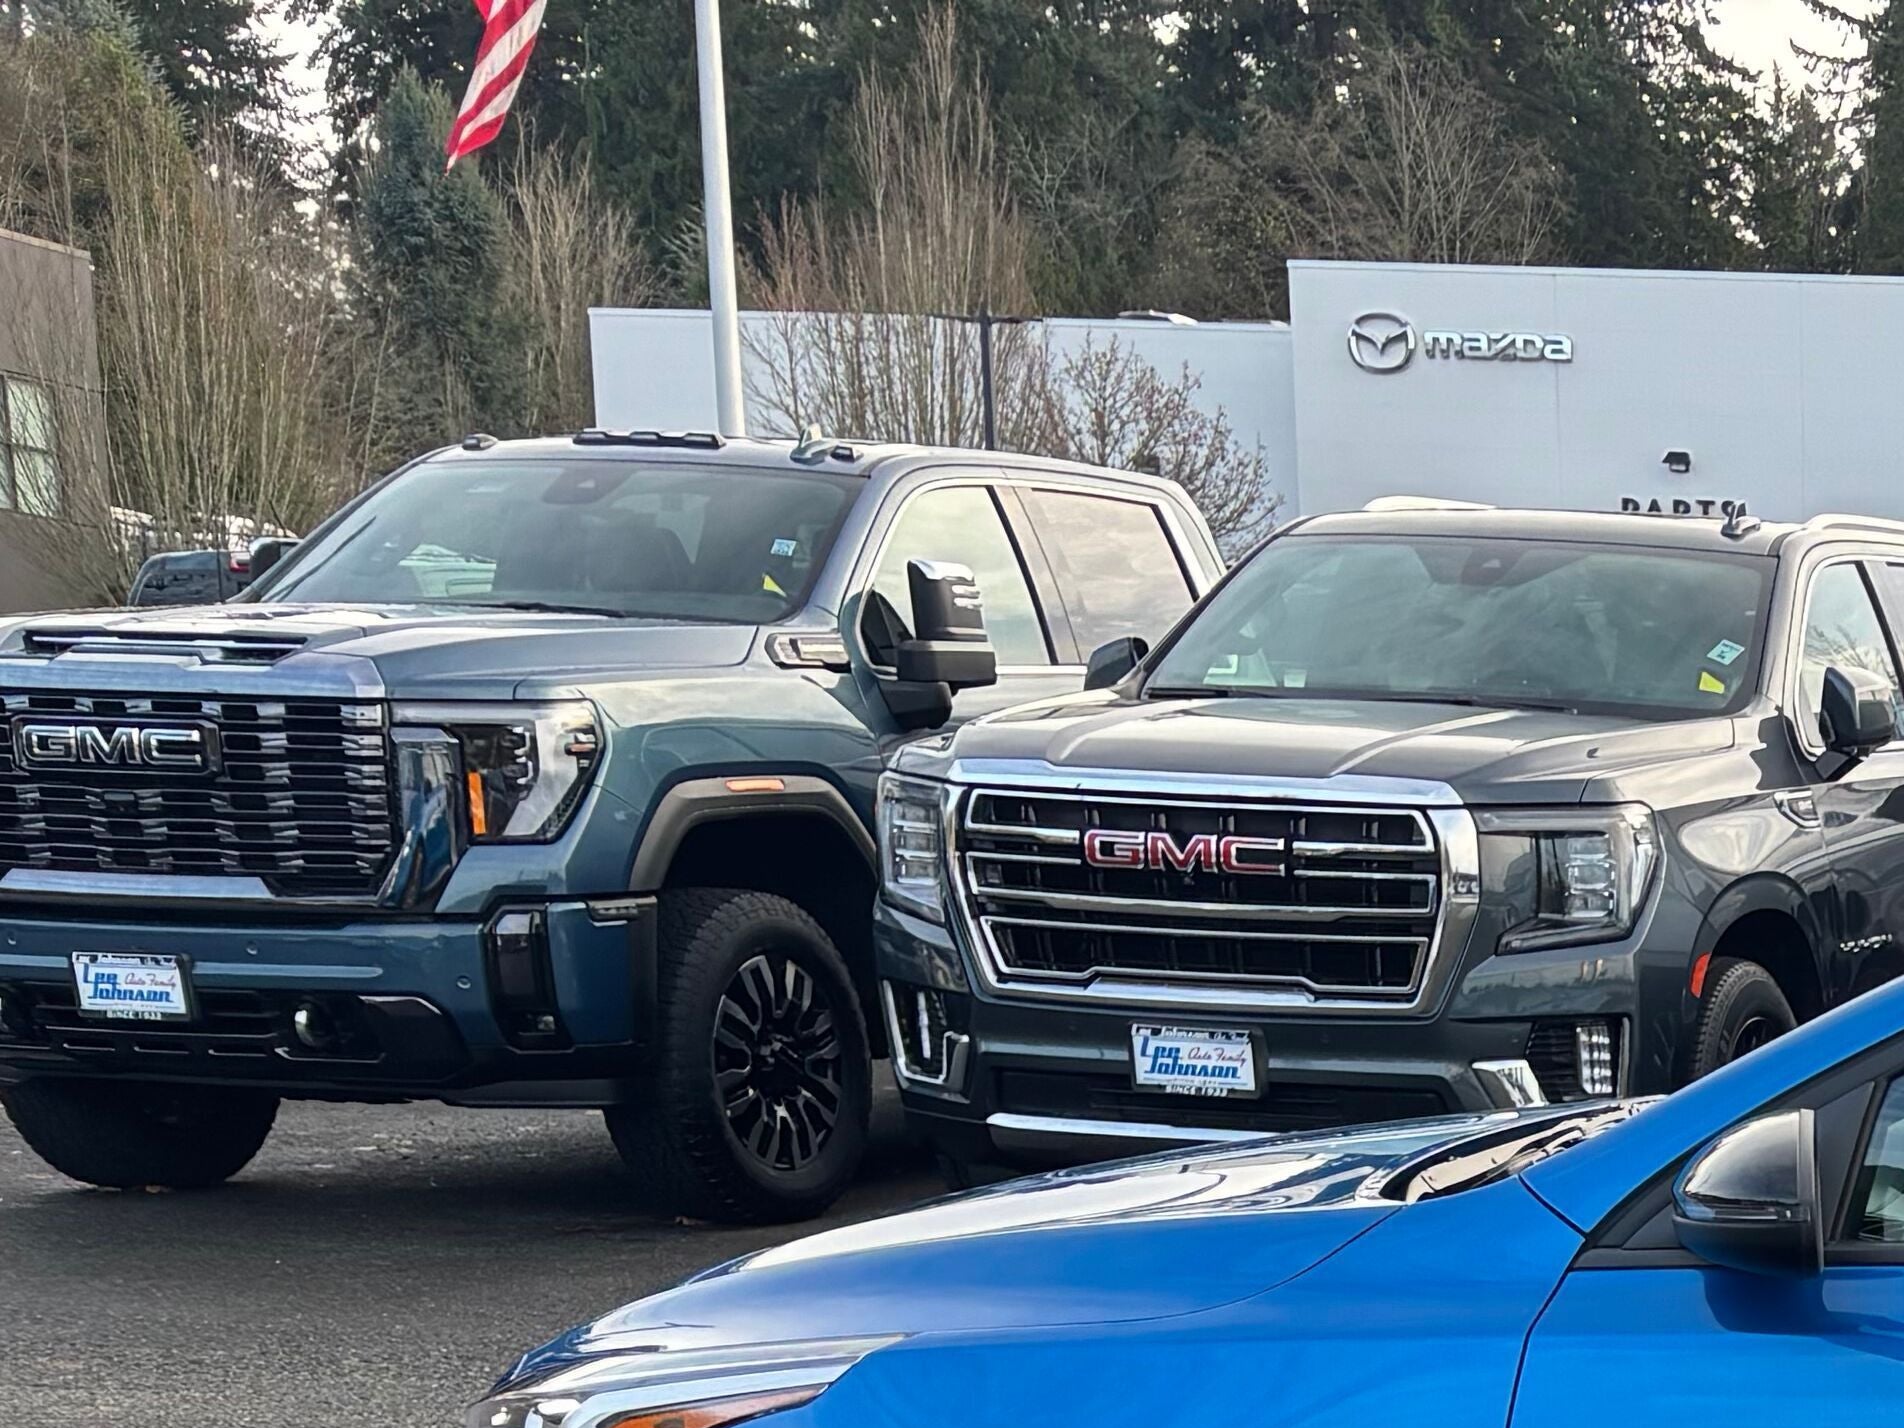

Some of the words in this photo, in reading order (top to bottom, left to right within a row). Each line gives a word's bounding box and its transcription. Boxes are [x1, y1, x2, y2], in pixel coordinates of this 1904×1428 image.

[1423, 329, 1573, 362] mazda
[23, 724, 202, 766] GMC
[1084, 829, 1285, 877] GMC
[83, 962, 120, 984] Lee
[88, 984, 174, 1002] Johnson
[1140, 1036, 1182, 1058] Lee
[1145, 1060, 1240, 1079] Johnson
